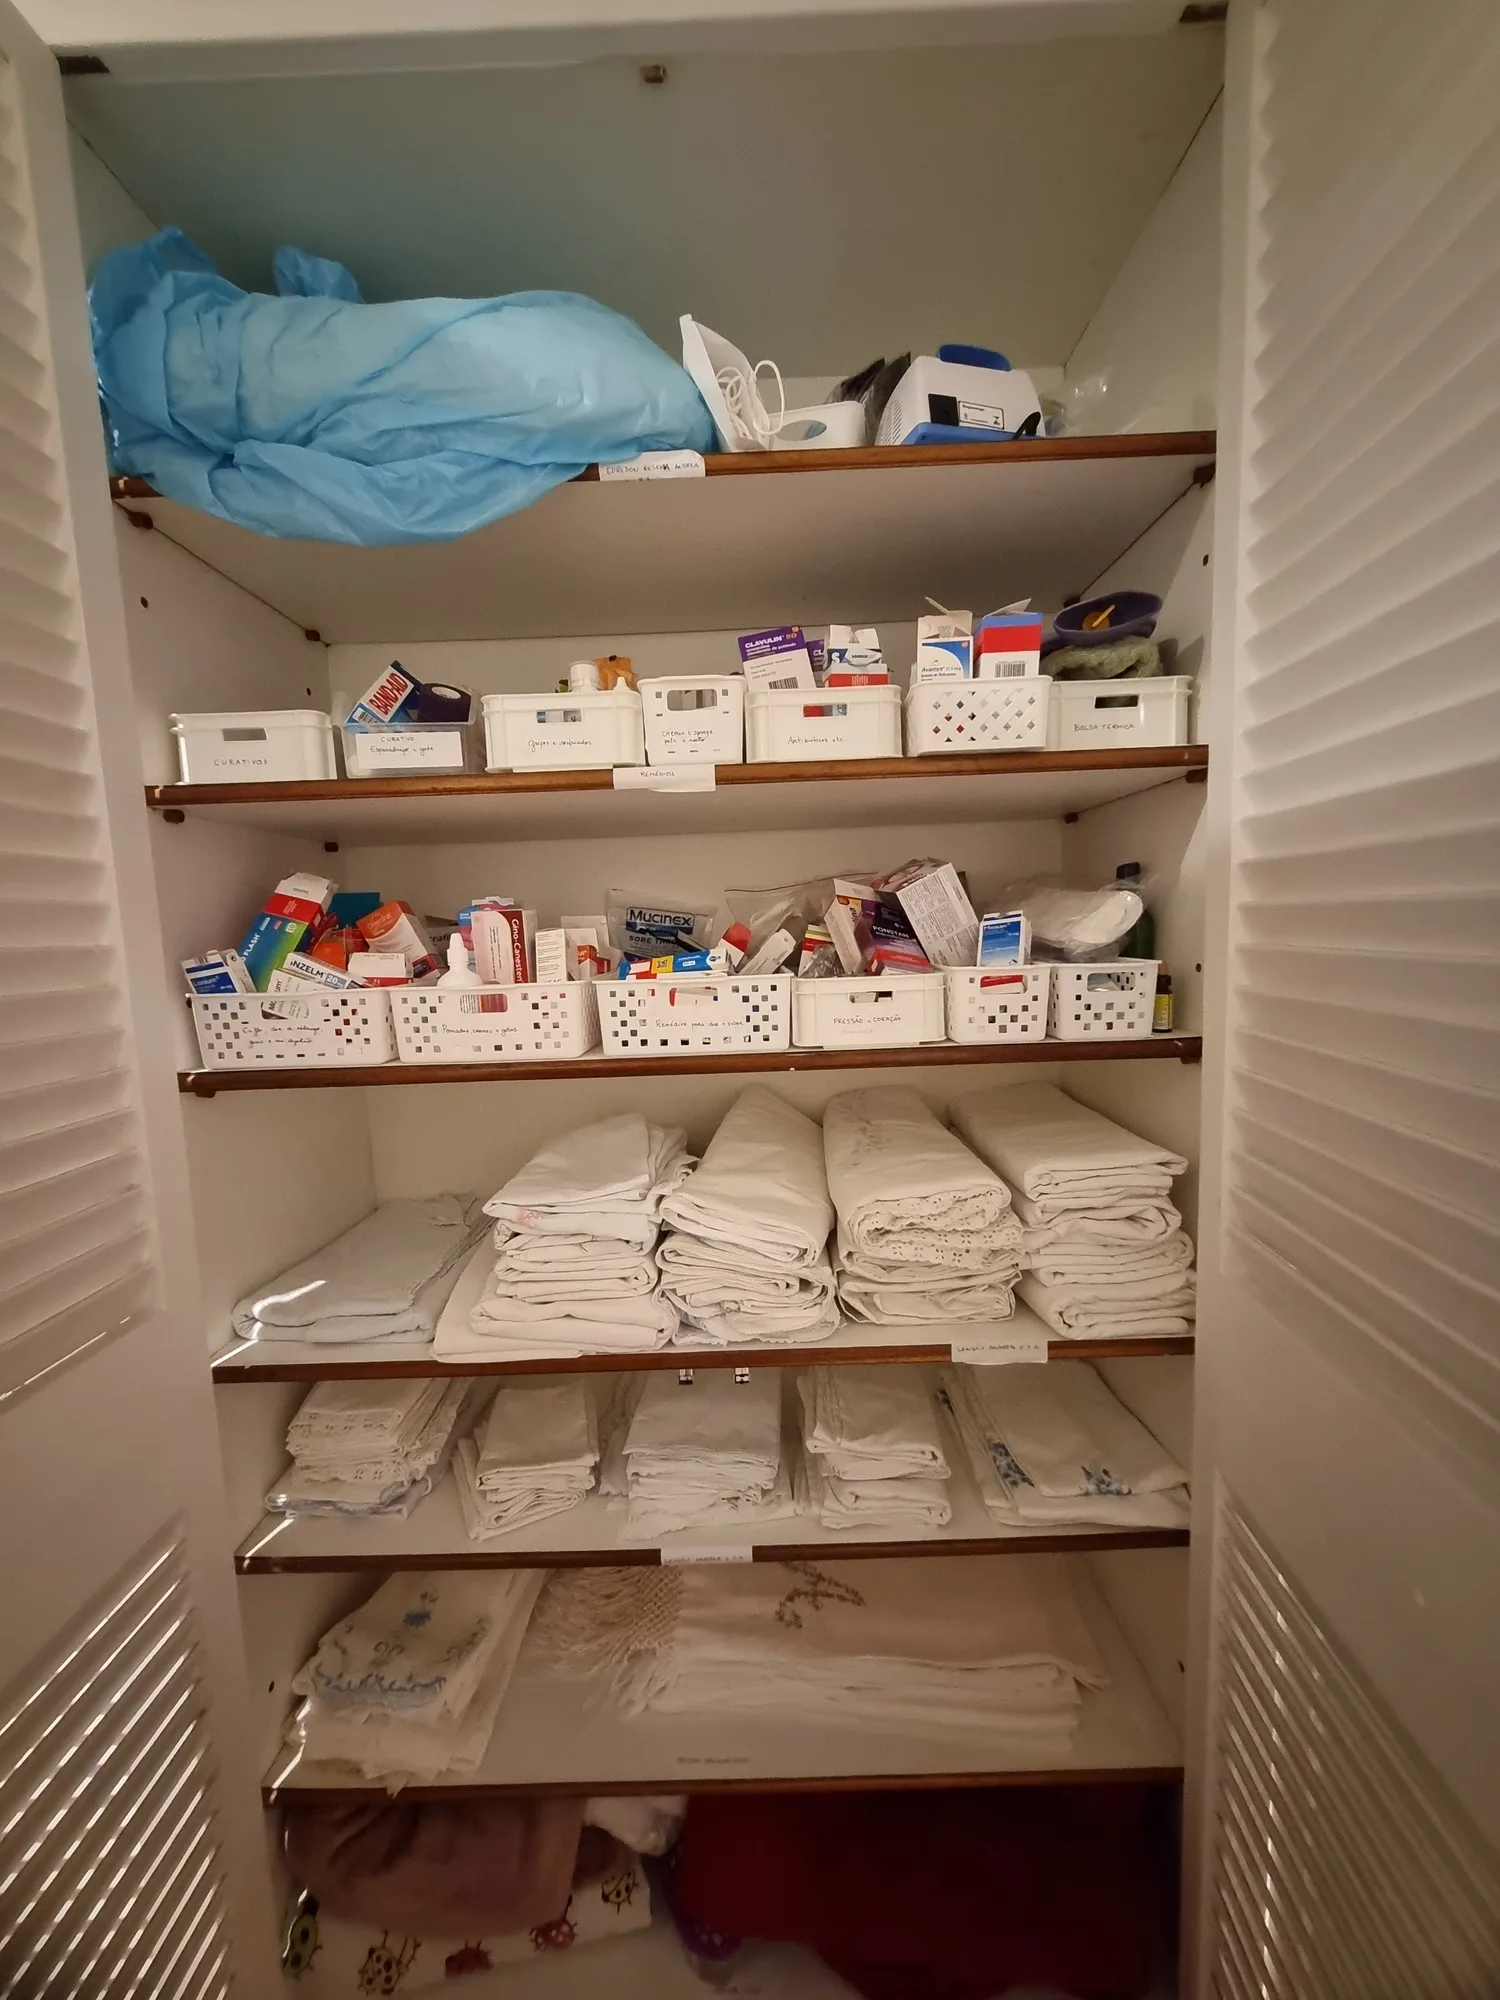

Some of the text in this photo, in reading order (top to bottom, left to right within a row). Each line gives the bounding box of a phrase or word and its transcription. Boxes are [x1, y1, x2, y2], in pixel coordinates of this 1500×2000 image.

[744, 635, 783, 649] CLAVULIN
[368, 672, 409, 716] BAND-AID
[1073, 723, 1099, 732] BOLSA
[213, 759, 268, 767] CURATIVOS
[242, 933, 260, 957] FLASH
[629, 935, 653, 944] SORE
[511, 918, 523, 982] Gino-Canesten
[833, 1014, 864, 1024] PRESSÃO
[872, 1013, 902, 1023] CORAÇÃO
